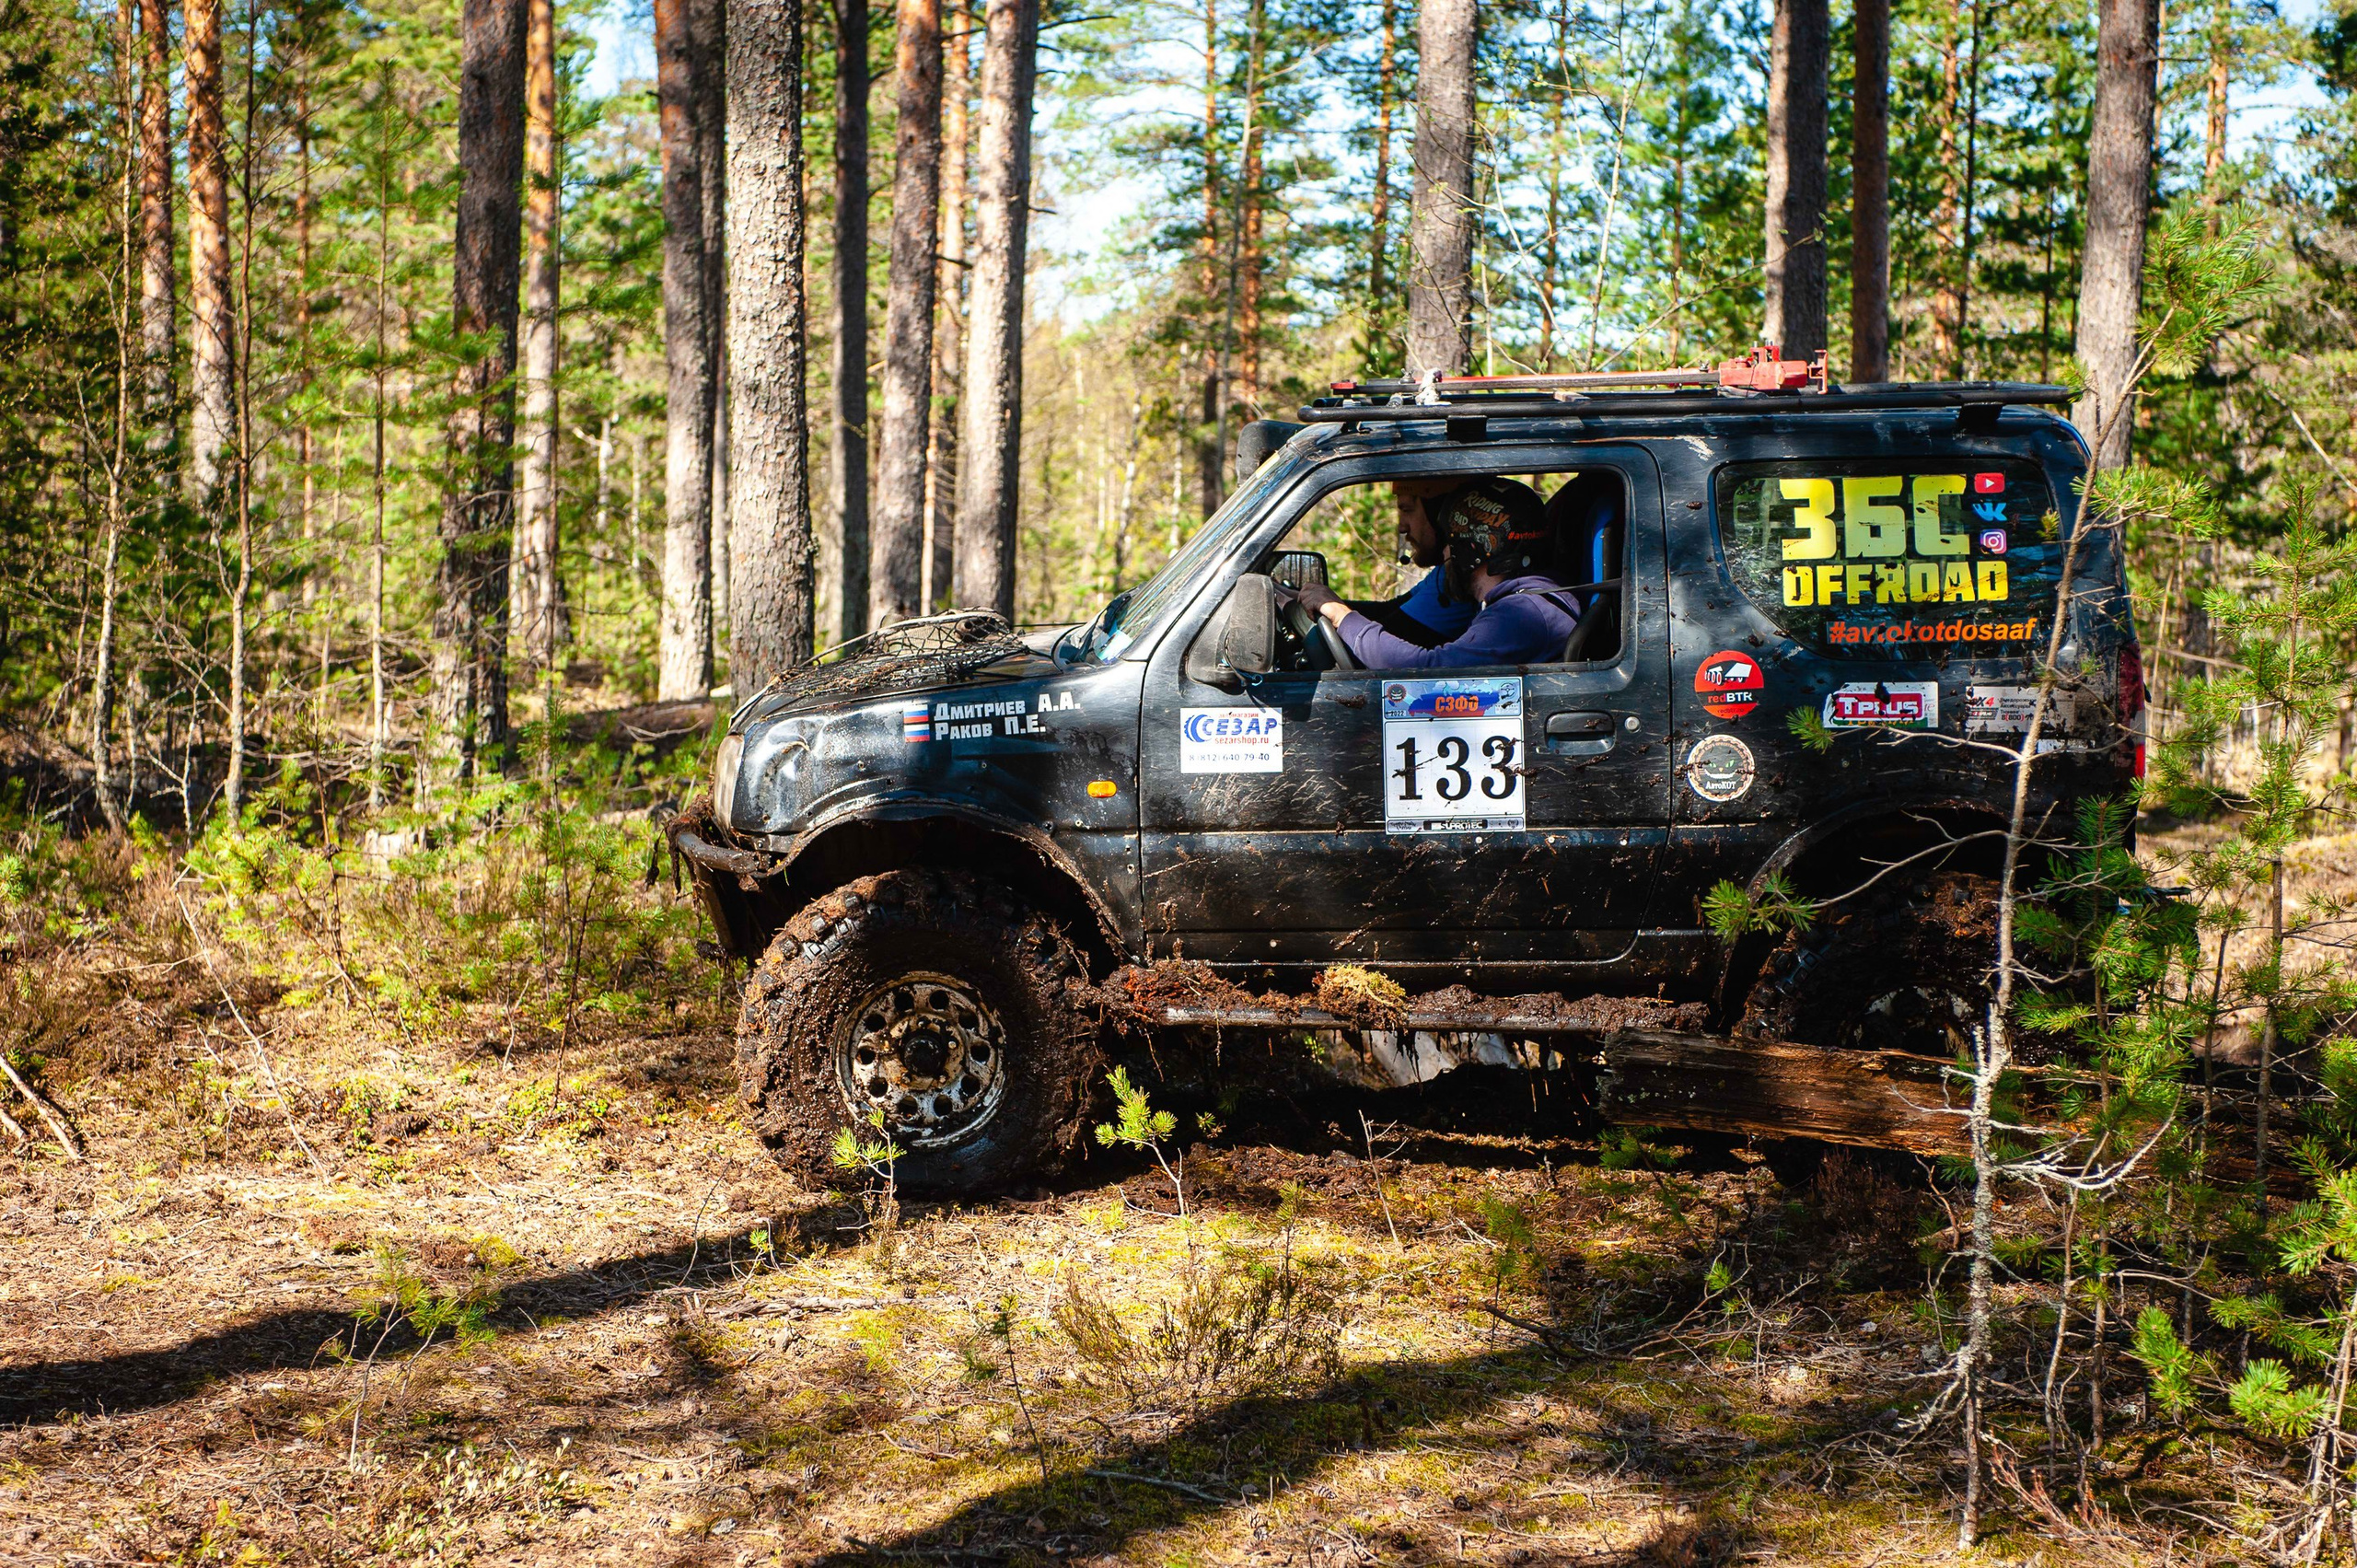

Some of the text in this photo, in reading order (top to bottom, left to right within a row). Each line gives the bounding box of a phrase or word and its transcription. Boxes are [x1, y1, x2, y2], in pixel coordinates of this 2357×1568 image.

[1464, 490, 1505, 514] RIDING
[1454, 511, 1469, 526] BAD
[1782, 561, 2009, 607] OFFROAD
[1708, 691, 1753, 703] redBTR
[1004, 714, 1046, 735] П.Е.
[1202, 718, 1278, 736] СЕЗАР
[1214, 737, 1270, 746] sezarshop.ru
[1396, 736, 1517, 801] 133
